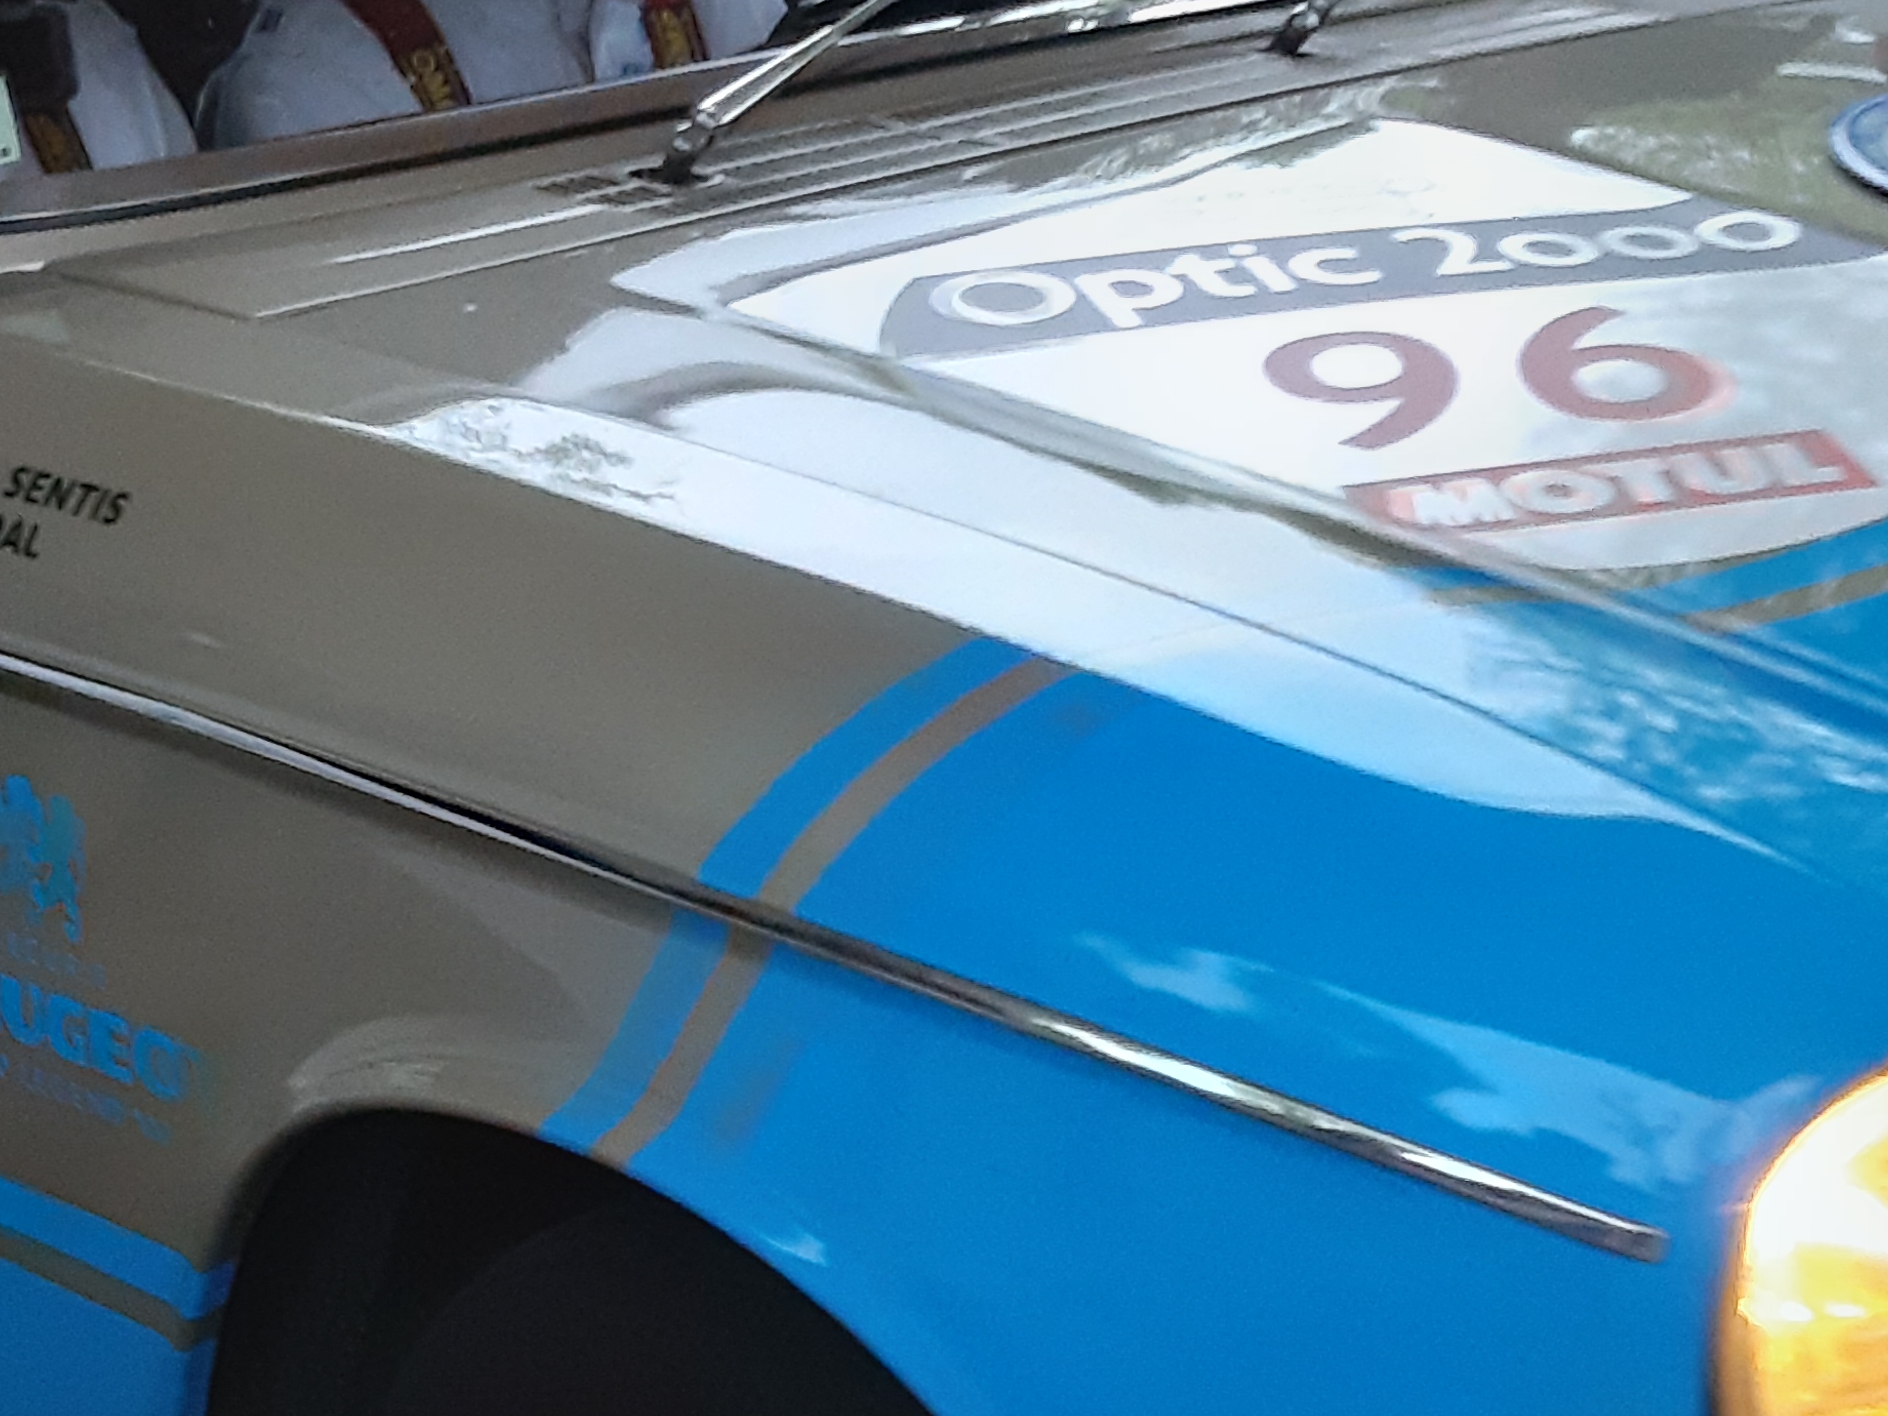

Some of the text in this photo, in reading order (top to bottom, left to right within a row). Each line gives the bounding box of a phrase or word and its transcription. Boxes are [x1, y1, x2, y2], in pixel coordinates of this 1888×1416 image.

[930, 206, 1806, 331] Optic 2000
[1262, 306, 1737, 452] 96
[4, 466, 131, 525] SENTIS
[1387, 436, 1844, 530] MOTUL
